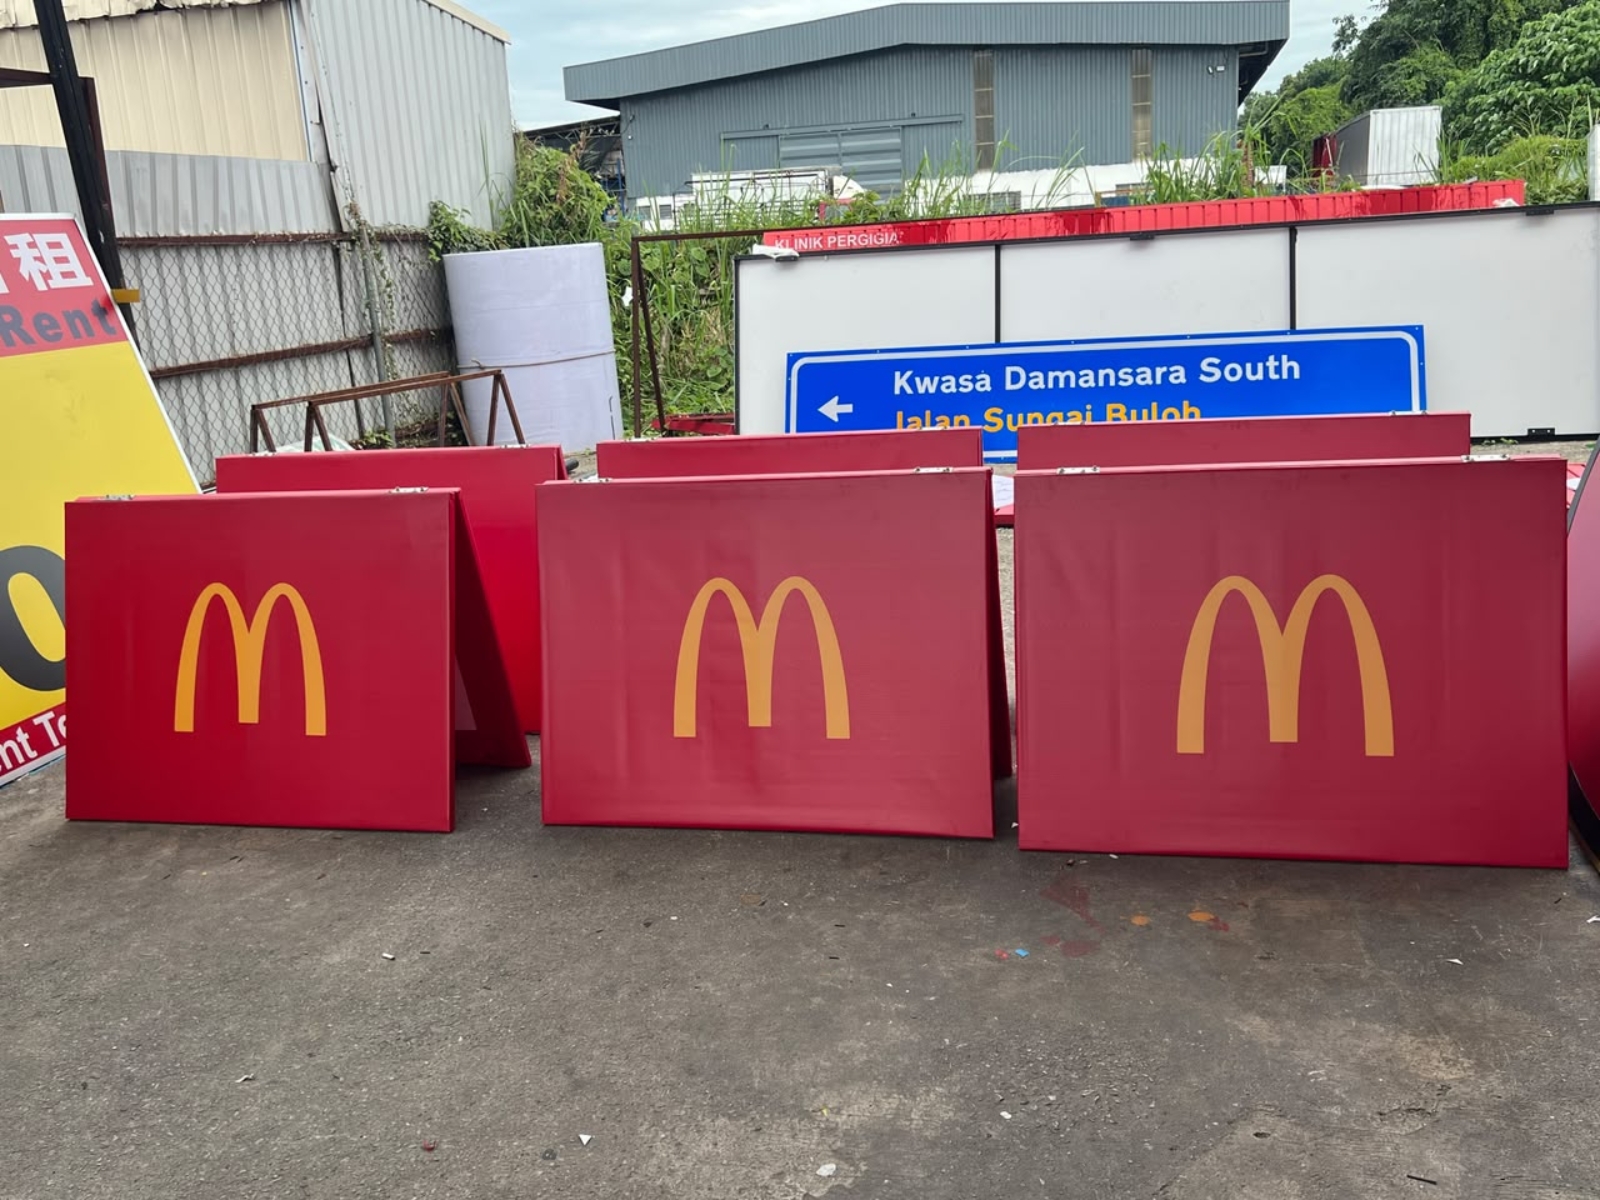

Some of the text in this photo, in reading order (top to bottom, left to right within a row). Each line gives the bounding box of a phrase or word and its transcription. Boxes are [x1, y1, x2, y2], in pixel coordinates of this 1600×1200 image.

[0, 298, 117, 347] Rent
[893, 354, 1300, 395] Kwasa Damansara South
[0, 726, 39, 772] nt
